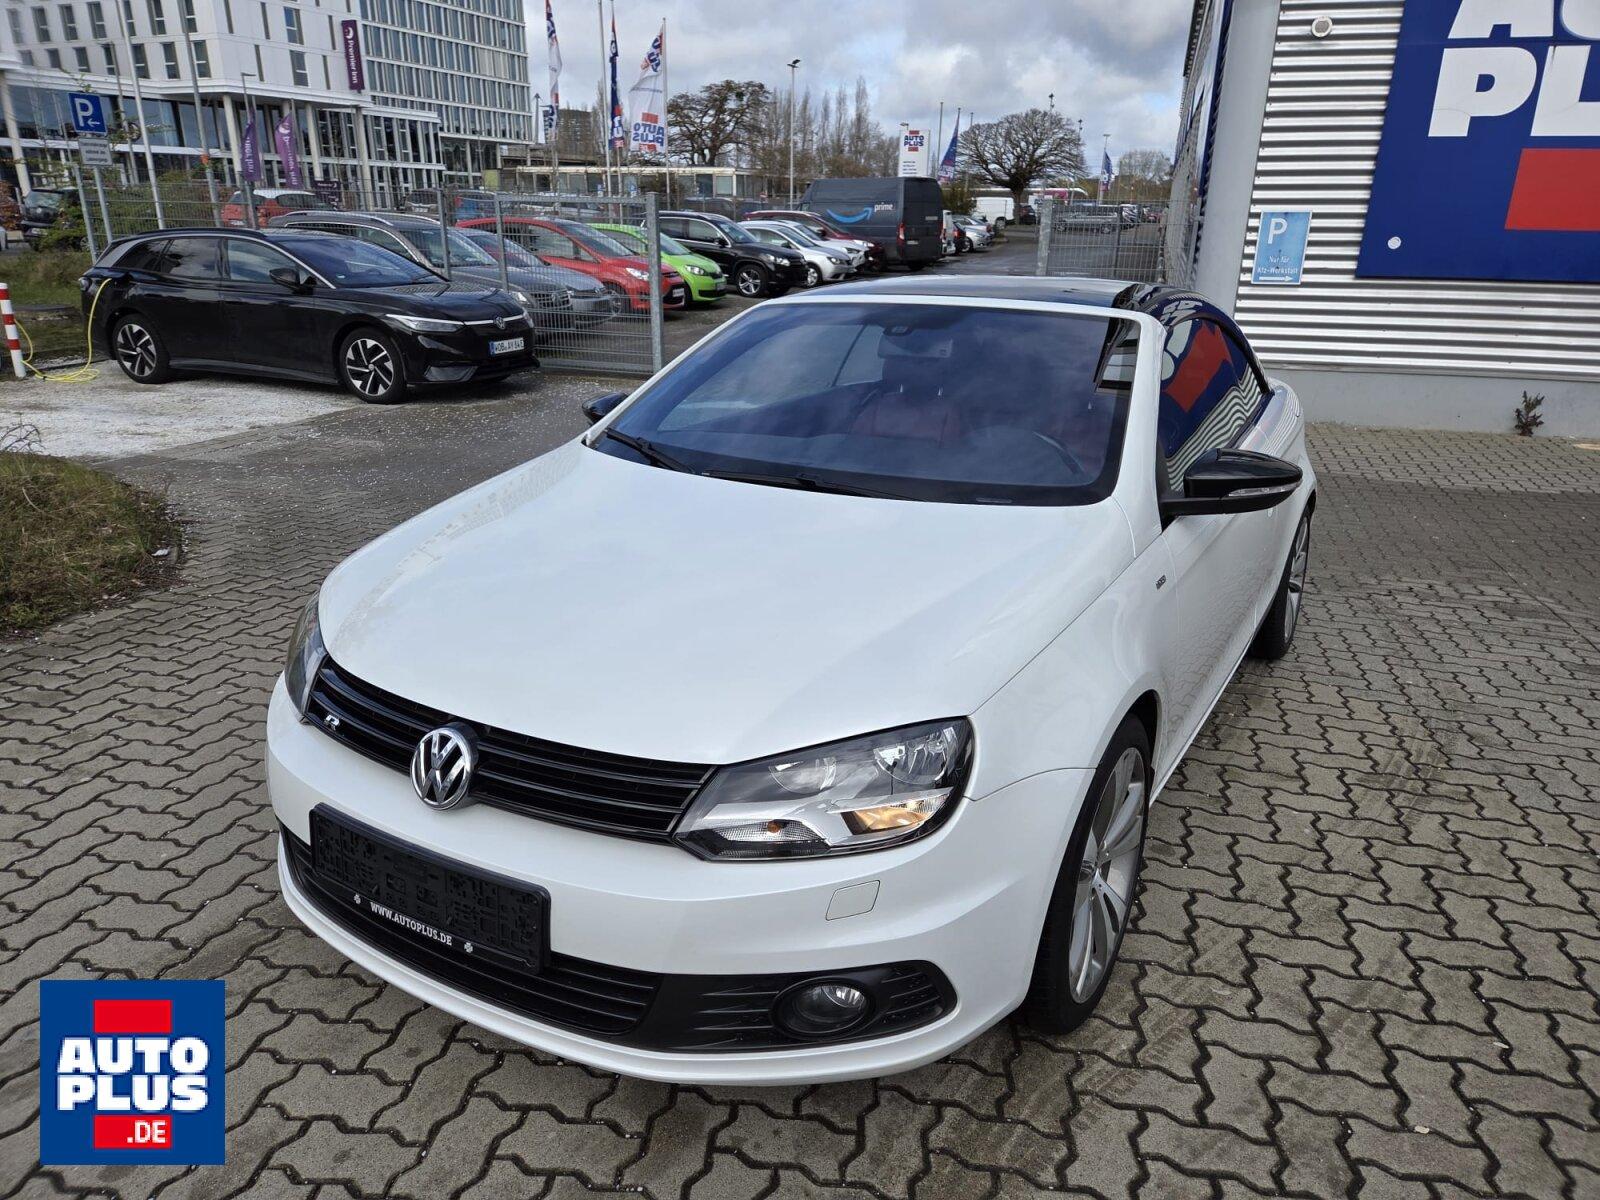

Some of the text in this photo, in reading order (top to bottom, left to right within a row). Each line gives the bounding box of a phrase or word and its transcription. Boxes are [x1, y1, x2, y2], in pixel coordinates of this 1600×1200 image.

[348, 40, 356, 70] Premier
[75, 98, 93, 127] P
[874, 202, 893, 212] prime
[1268, 218, 1288, 244] P
[370, 902, 452, 946] WWW.AUTOPLUS.DE
